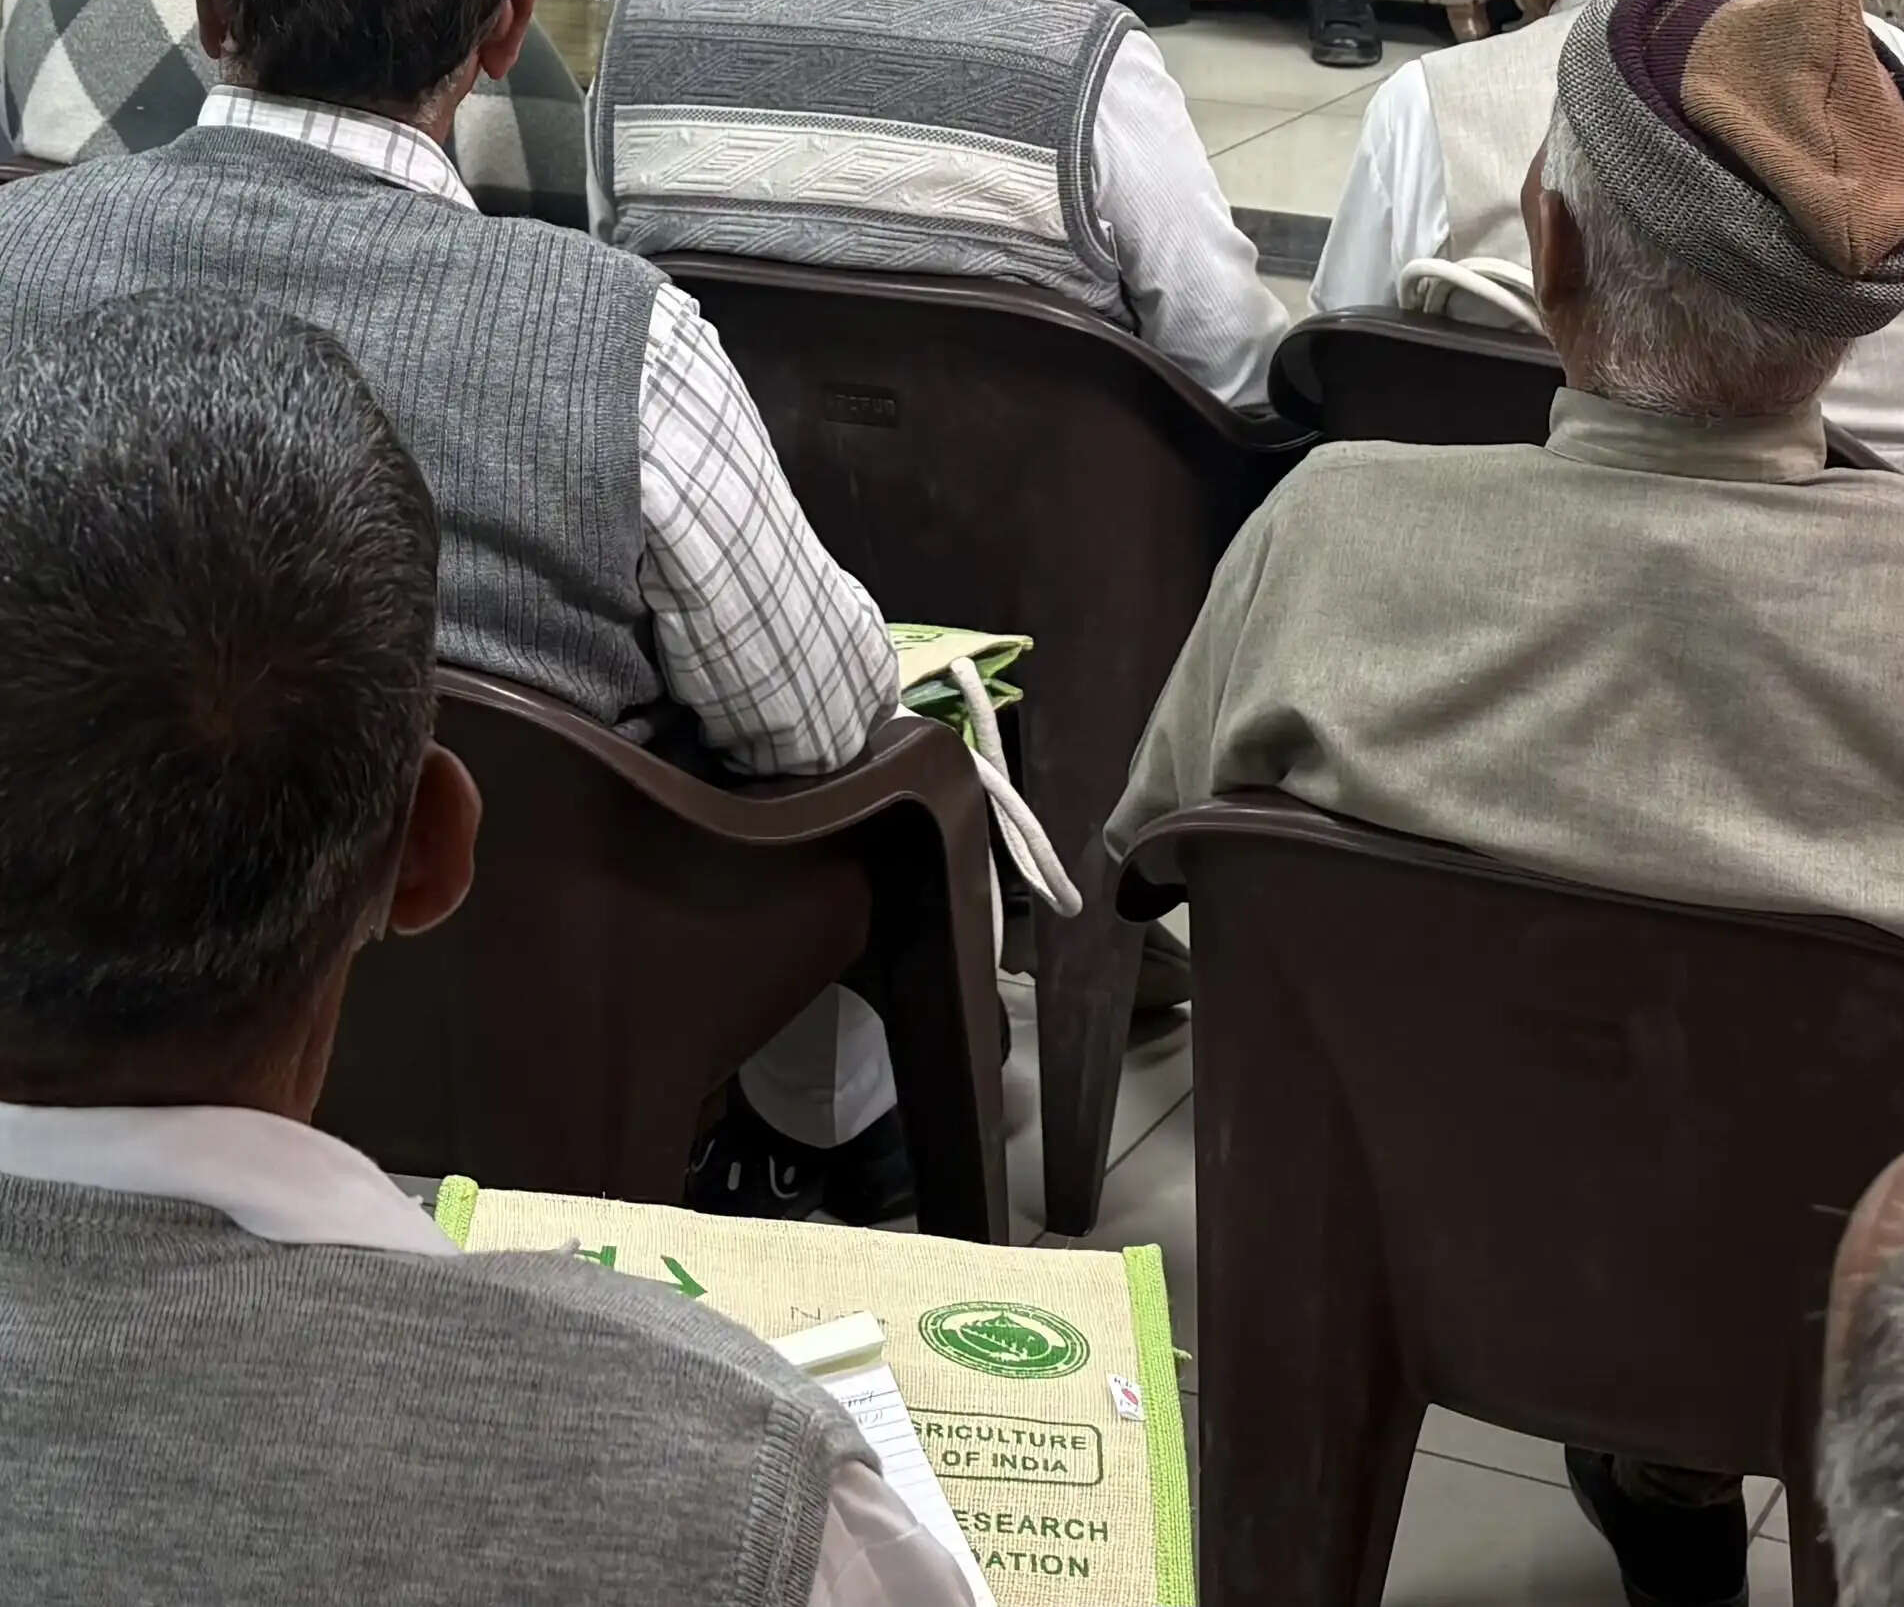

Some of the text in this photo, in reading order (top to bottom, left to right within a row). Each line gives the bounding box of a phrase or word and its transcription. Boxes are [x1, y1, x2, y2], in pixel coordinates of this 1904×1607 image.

[912, 1420, 1088, 1451] RICULTURE
[942, 1450, 1069, 1473] OF INDIA
[954, 1509, 1110, 1543] ESEARCH
